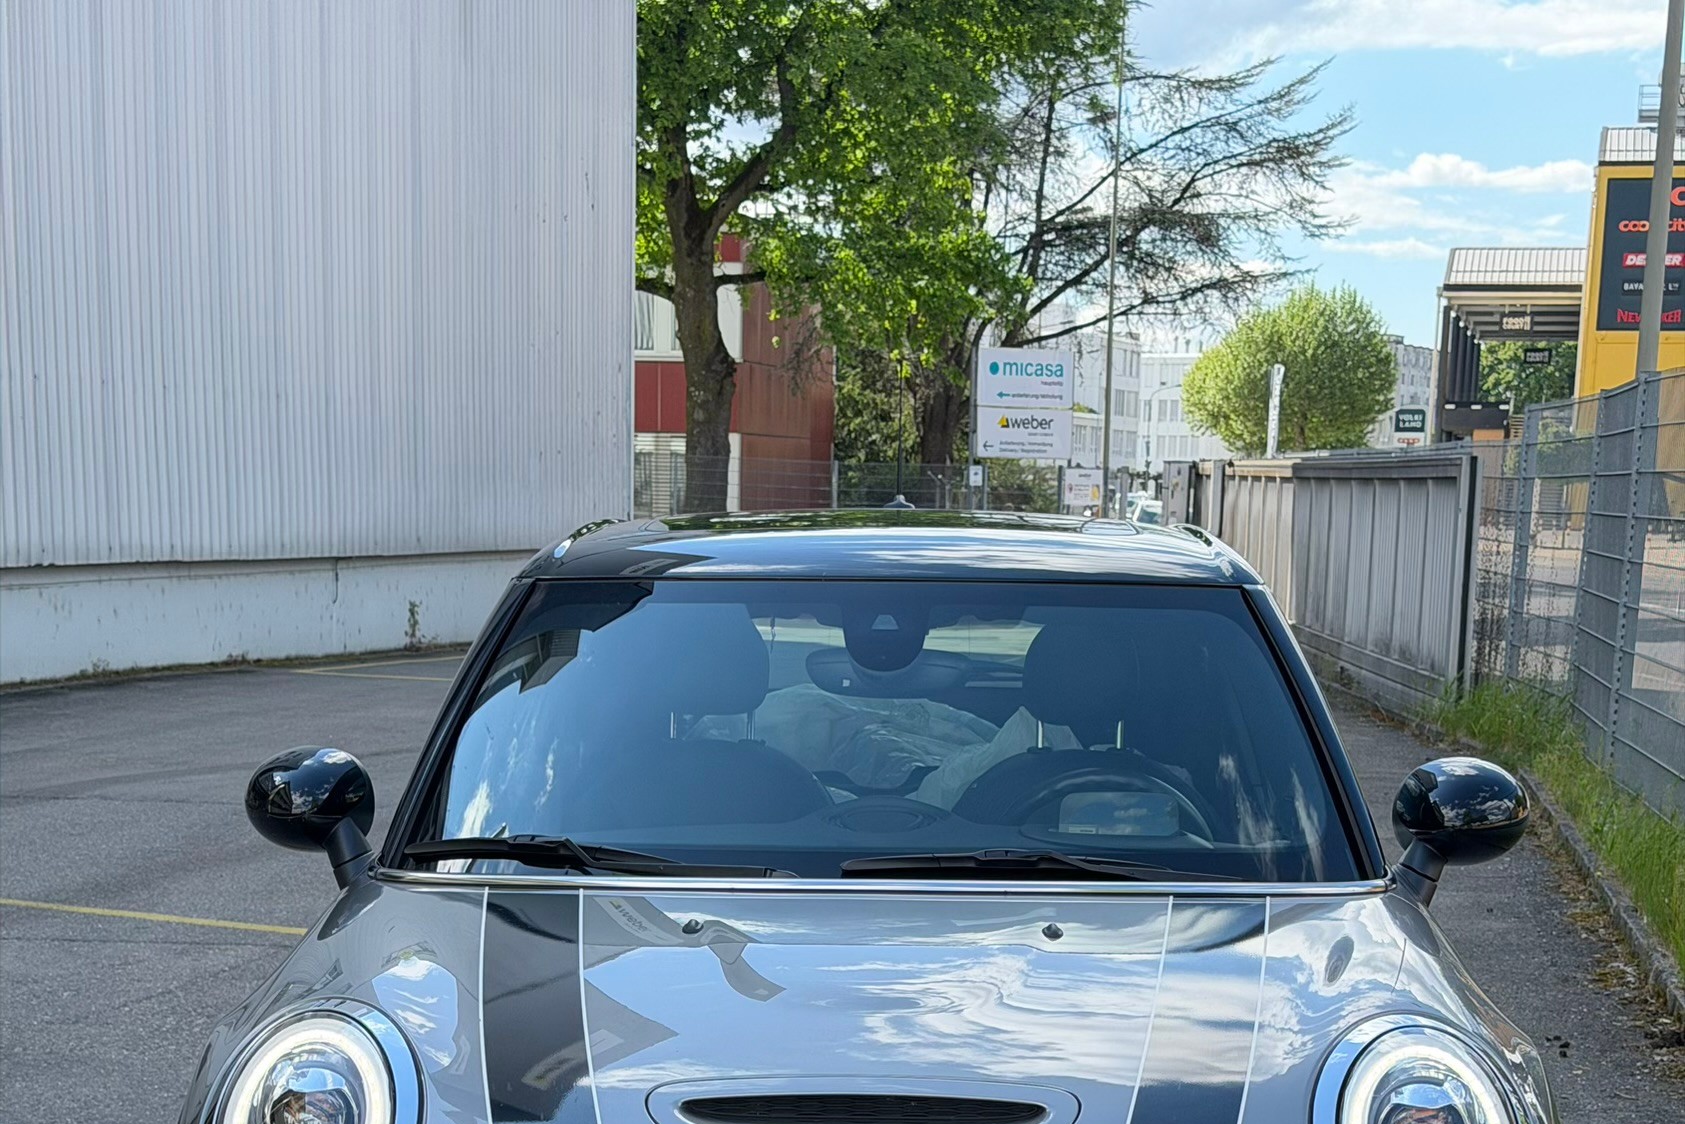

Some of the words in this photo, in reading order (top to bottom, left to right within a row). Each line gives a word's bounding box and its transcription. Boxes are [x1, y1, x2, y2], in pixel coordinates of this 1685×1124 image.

[1618, 220, 1650, 232] coo
[1625, 254, 1683, 267] DEER
[1002, 361, 1064, 378] micasa
[1010, 414, 1054, 430] weber
